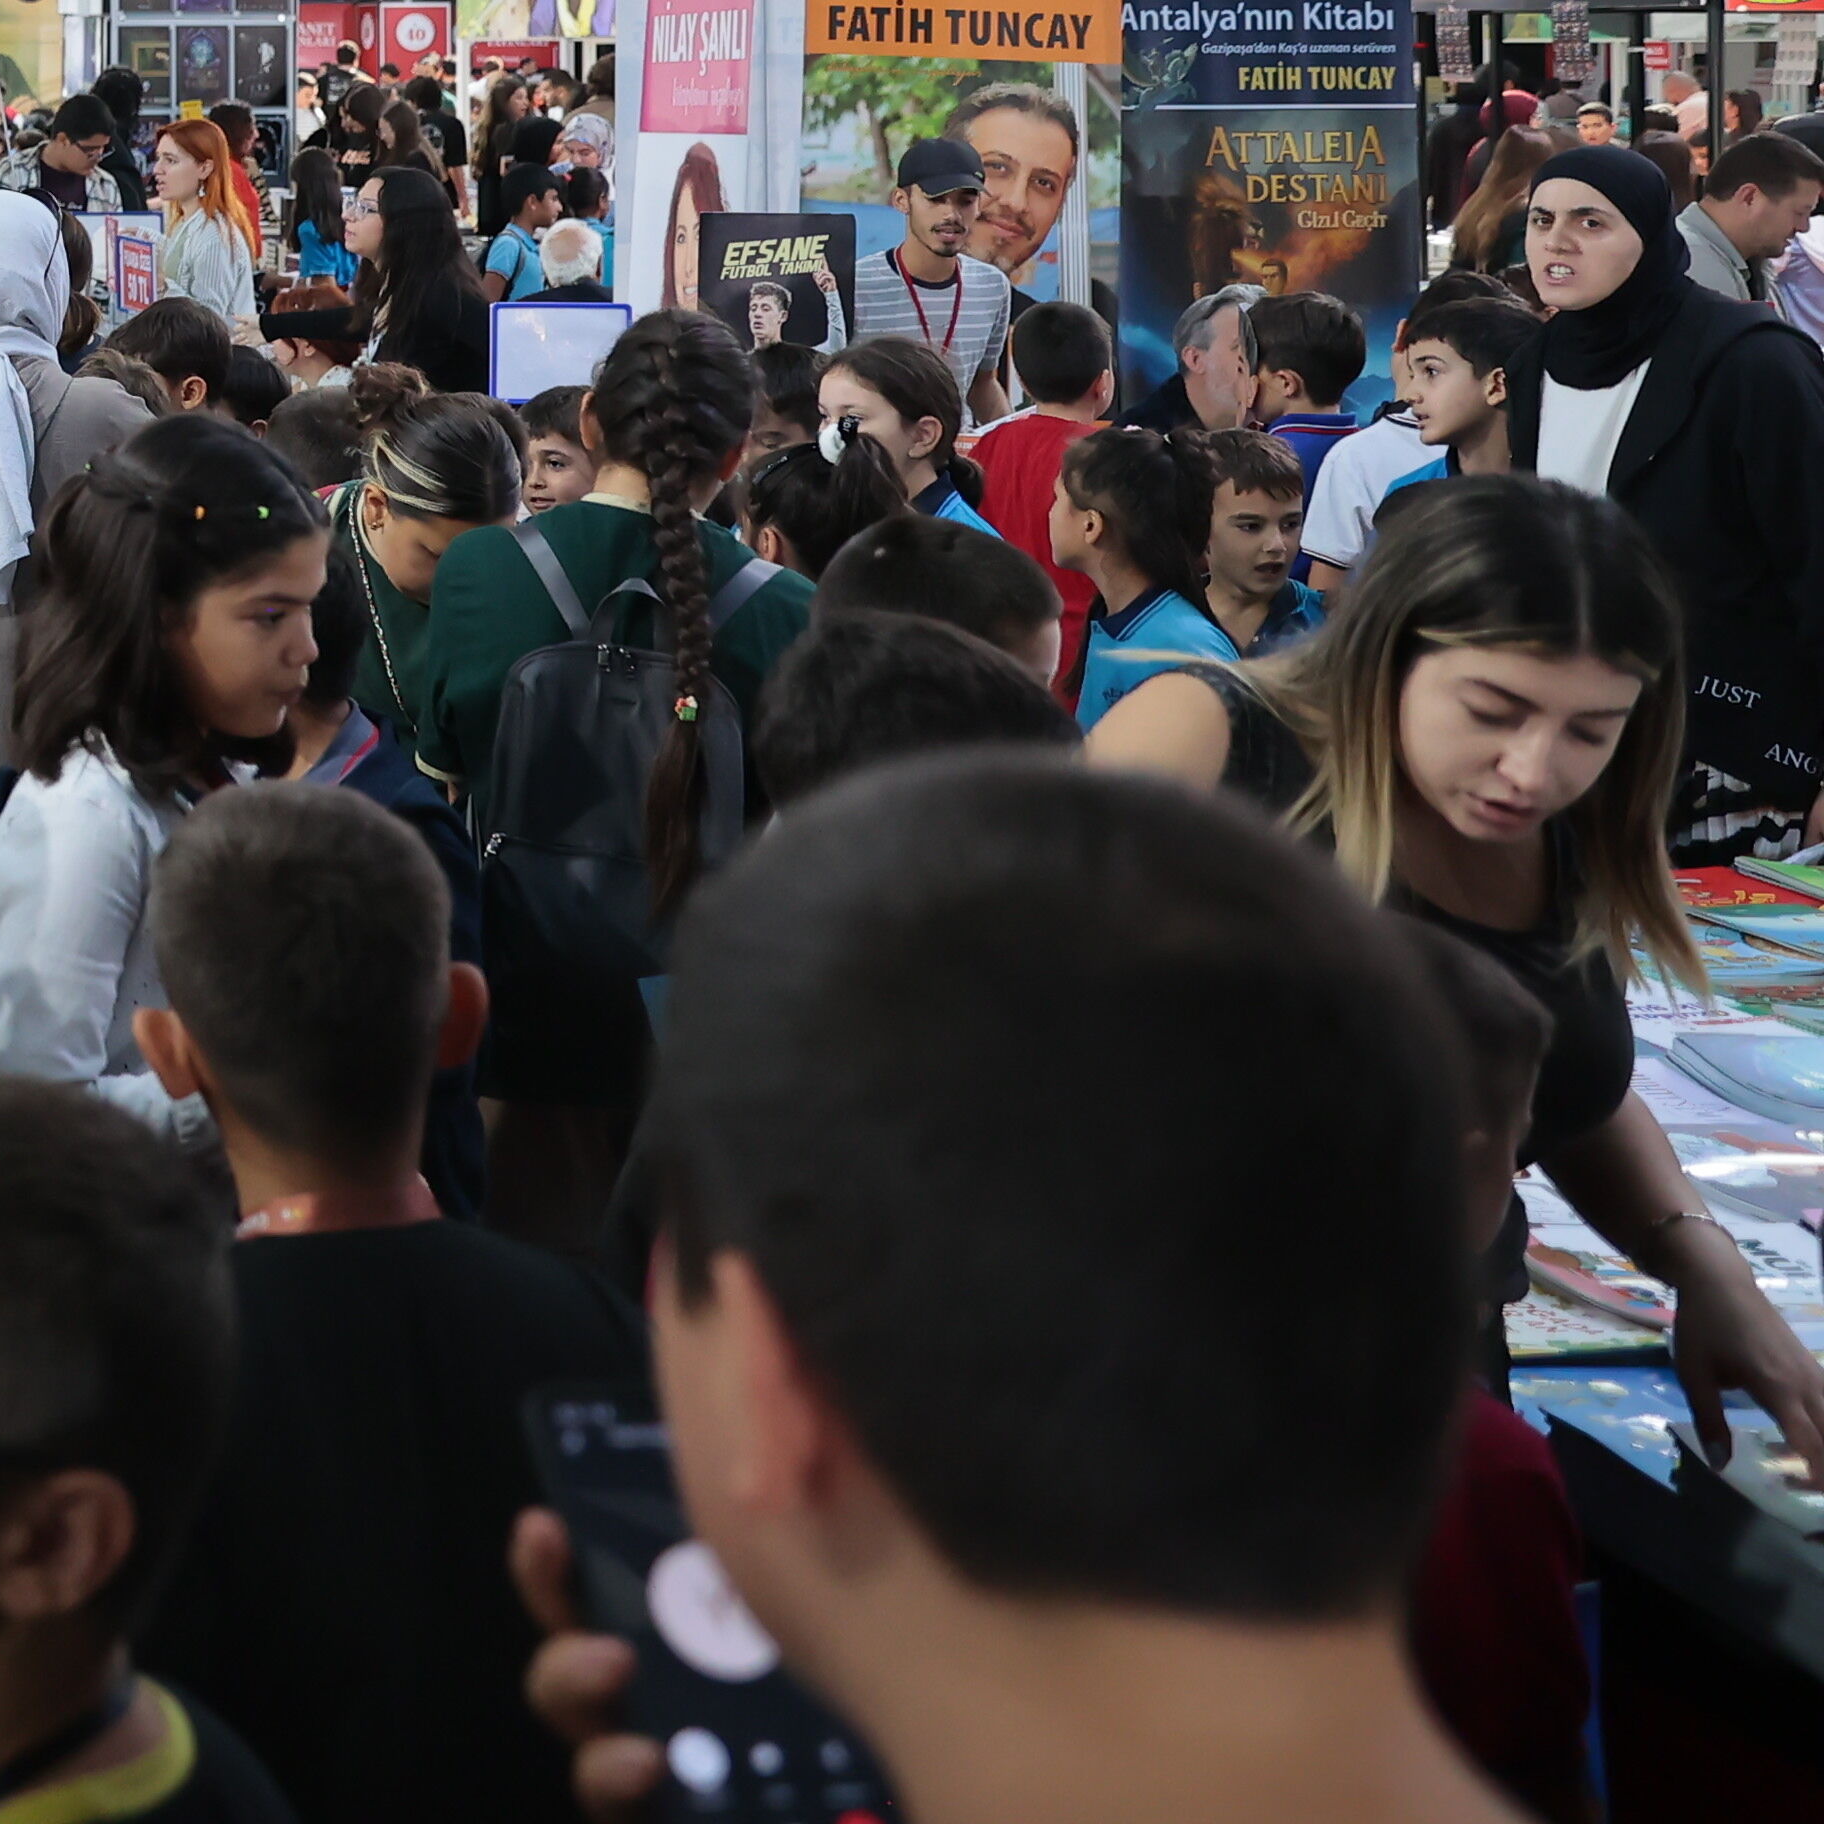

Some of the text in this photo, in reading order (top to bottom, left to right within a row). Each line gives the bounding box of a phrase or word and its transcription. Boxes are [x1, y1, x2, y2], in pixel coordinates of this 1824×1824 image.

[828, 0, 1093, 50] FATİH TUNCAY
[1120, 1, 1394, 39] Antalya'nın Kitabı
[652, 1, 748, 76] NİLAY ŞANLI
[1202, 42, 1396, 57] Gazipaşa'dan Kaş'a uzanan serüven
[1239, 61, 1396, 90] FATİH TUNCAY
[1205, 125, 1387, 171] ATTALEIA
[1246, 174, 1387, 206] DESTANI
[724, 234, 830, 264] EFSANE
[720, 257, 823, 280] FUTBOL TAKIMI
[1694, 675, 1762, 709] JUST
